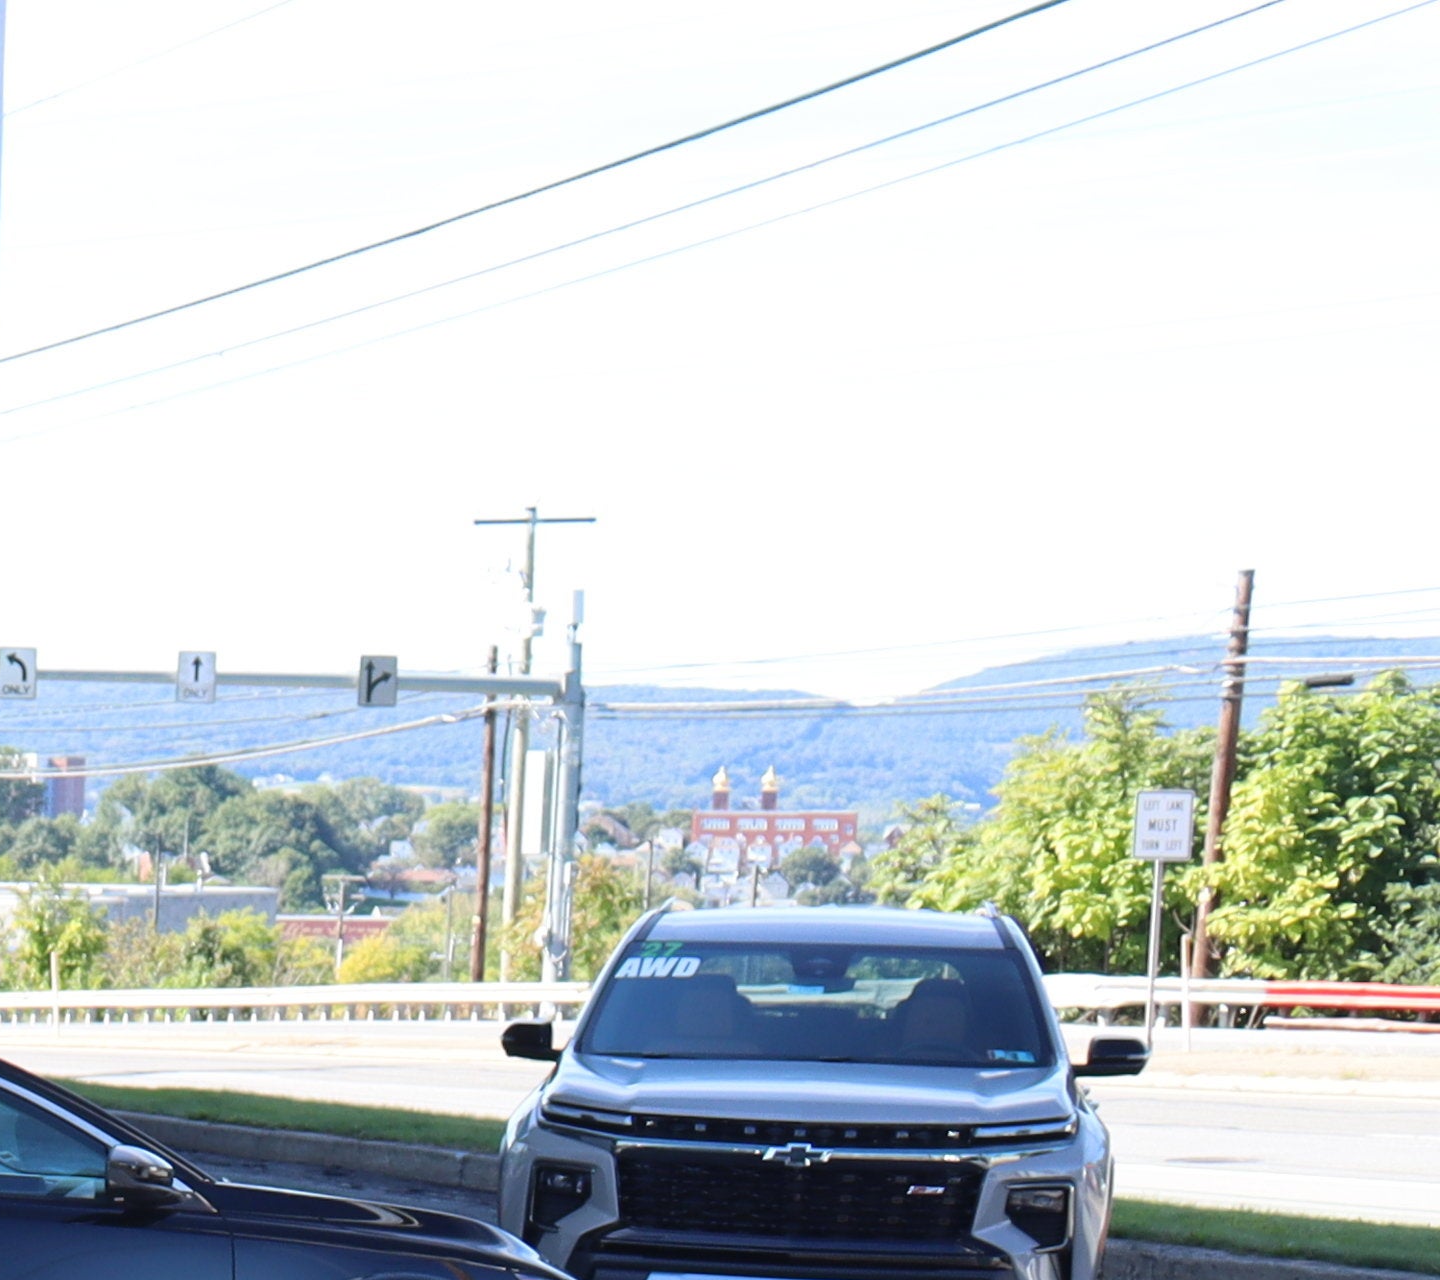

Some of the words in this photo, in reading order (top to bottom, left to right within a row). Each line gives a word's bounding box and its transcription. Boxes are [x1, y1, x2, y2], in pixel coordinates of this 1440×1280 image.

[2, 684, 30, 695] ONLY
[183, 687, 208, 697] ONLY
[1148, 818, 1178, 831] MUST
[614, 956, 701, 978] AWD
